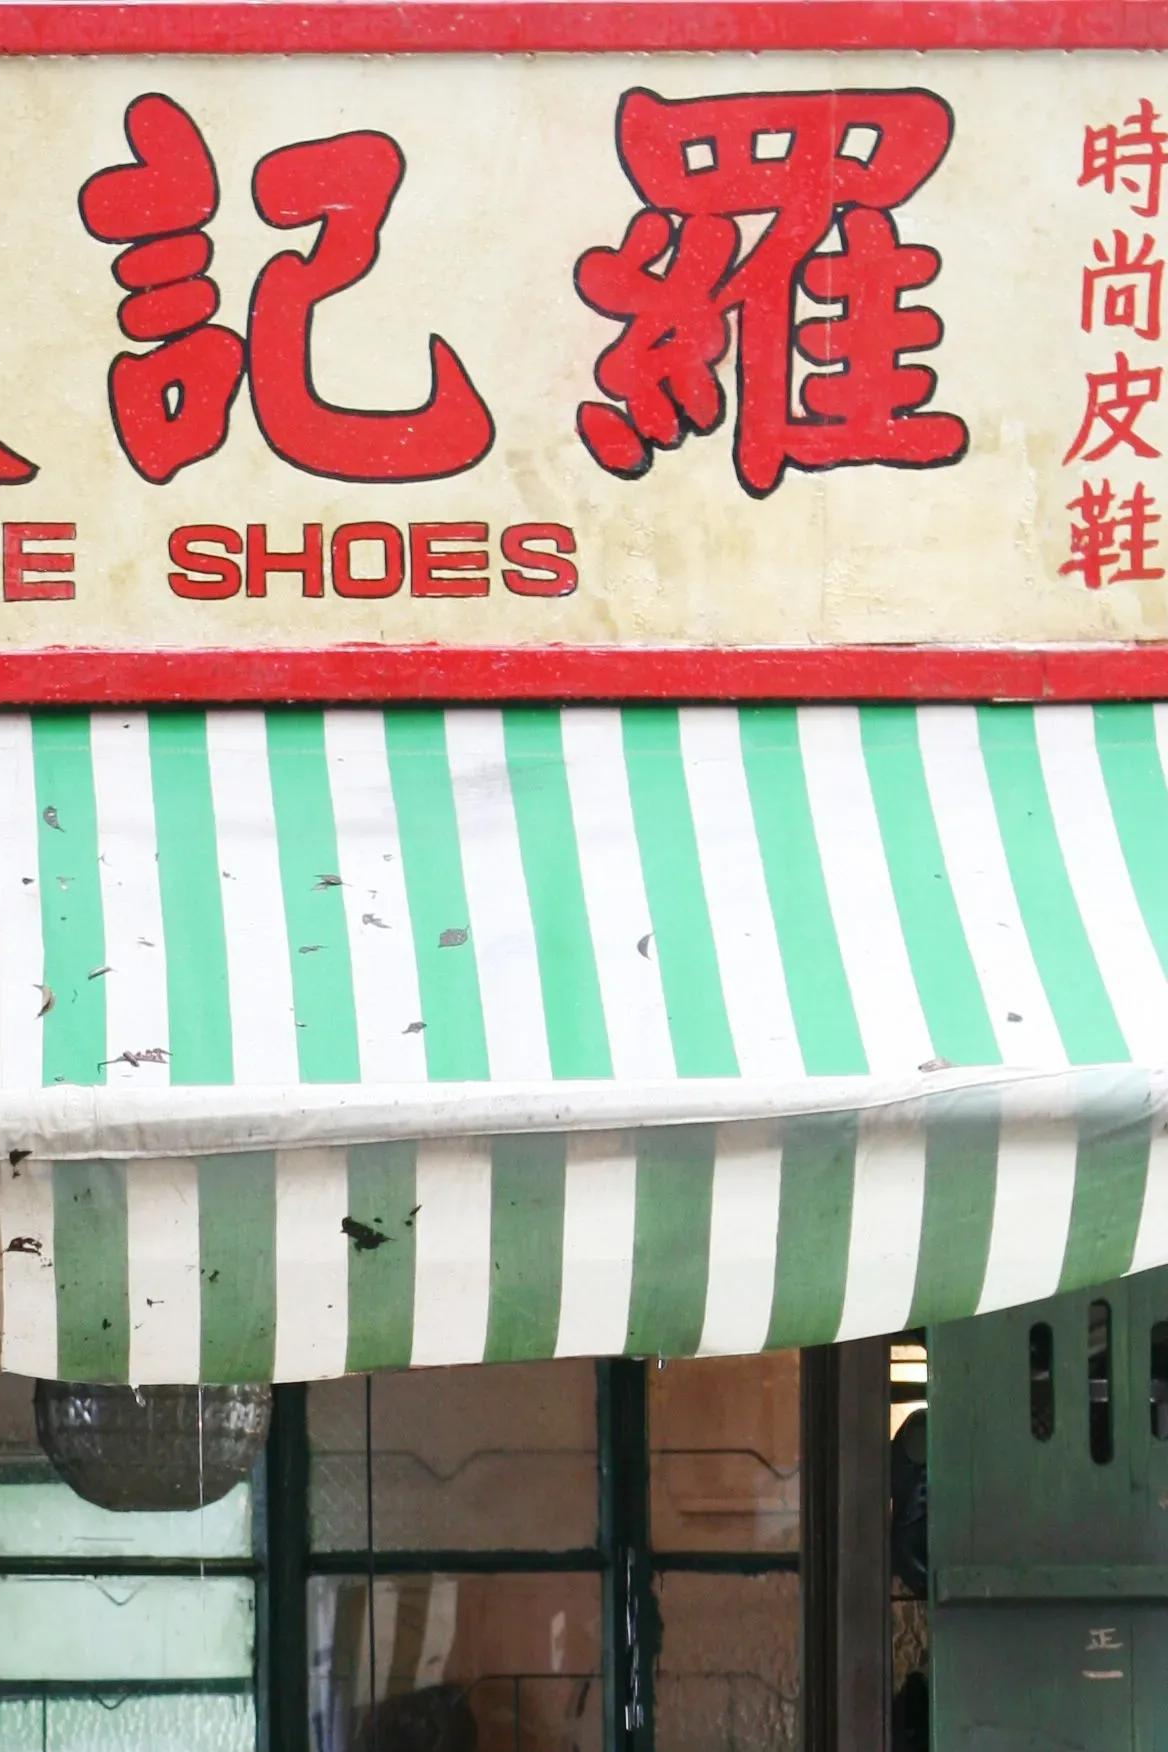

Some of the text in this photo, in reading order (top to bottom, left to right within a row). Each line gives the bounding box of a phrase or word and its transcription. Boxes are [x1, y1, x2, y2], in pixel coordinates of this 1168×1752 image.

[1058, 97, 1168, 590] 時尚皮鞋
[167, 521, 579, 601] SHOES
